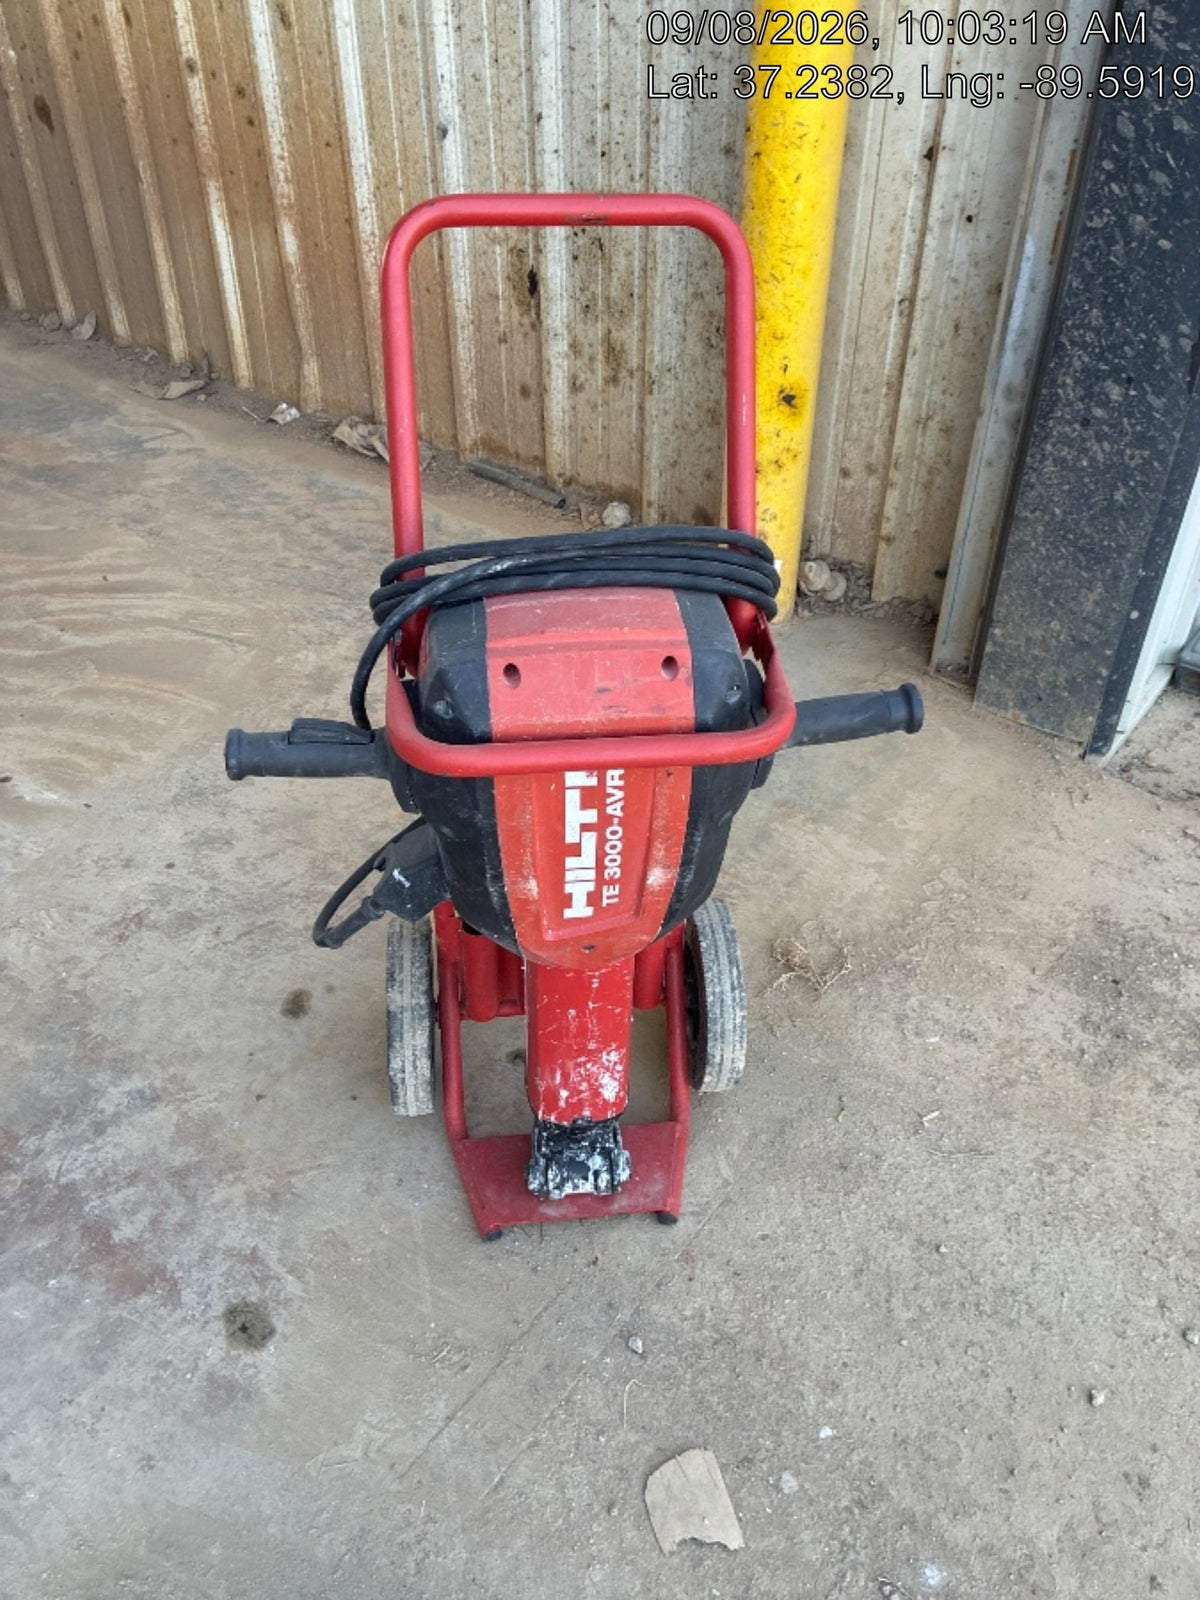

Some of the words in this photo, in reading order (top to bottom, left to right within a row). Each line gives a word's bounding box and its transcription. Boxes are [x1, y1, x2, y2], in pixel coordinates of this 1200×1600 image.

[563, 770, 598, 920] HILTI
[603, 768, 625, 880] 3000-AVR
[602, 884, 620, 907] TE
